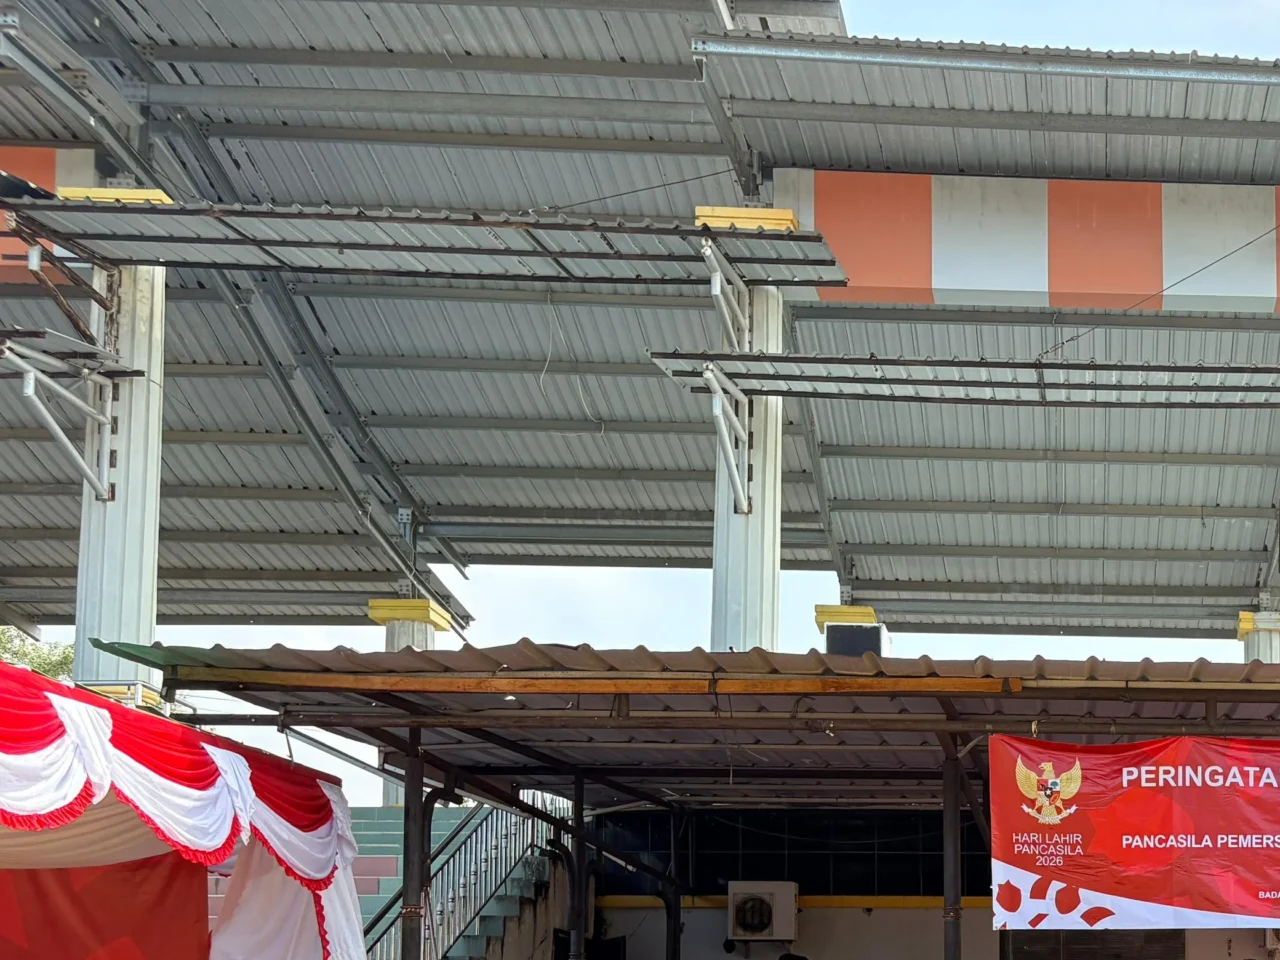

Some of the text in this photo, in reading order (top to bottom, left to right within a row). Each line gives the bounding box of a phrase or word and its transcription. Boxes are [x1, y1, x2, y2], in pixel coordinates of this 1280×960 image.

[1012, 832, 1083, 844] HARI LAHIR
[1122, 834, 1213, 849] PANCASILA
[1013, 843, 1084, 856] PANCASILA
[1035, 855, 1064, 867] 2026
